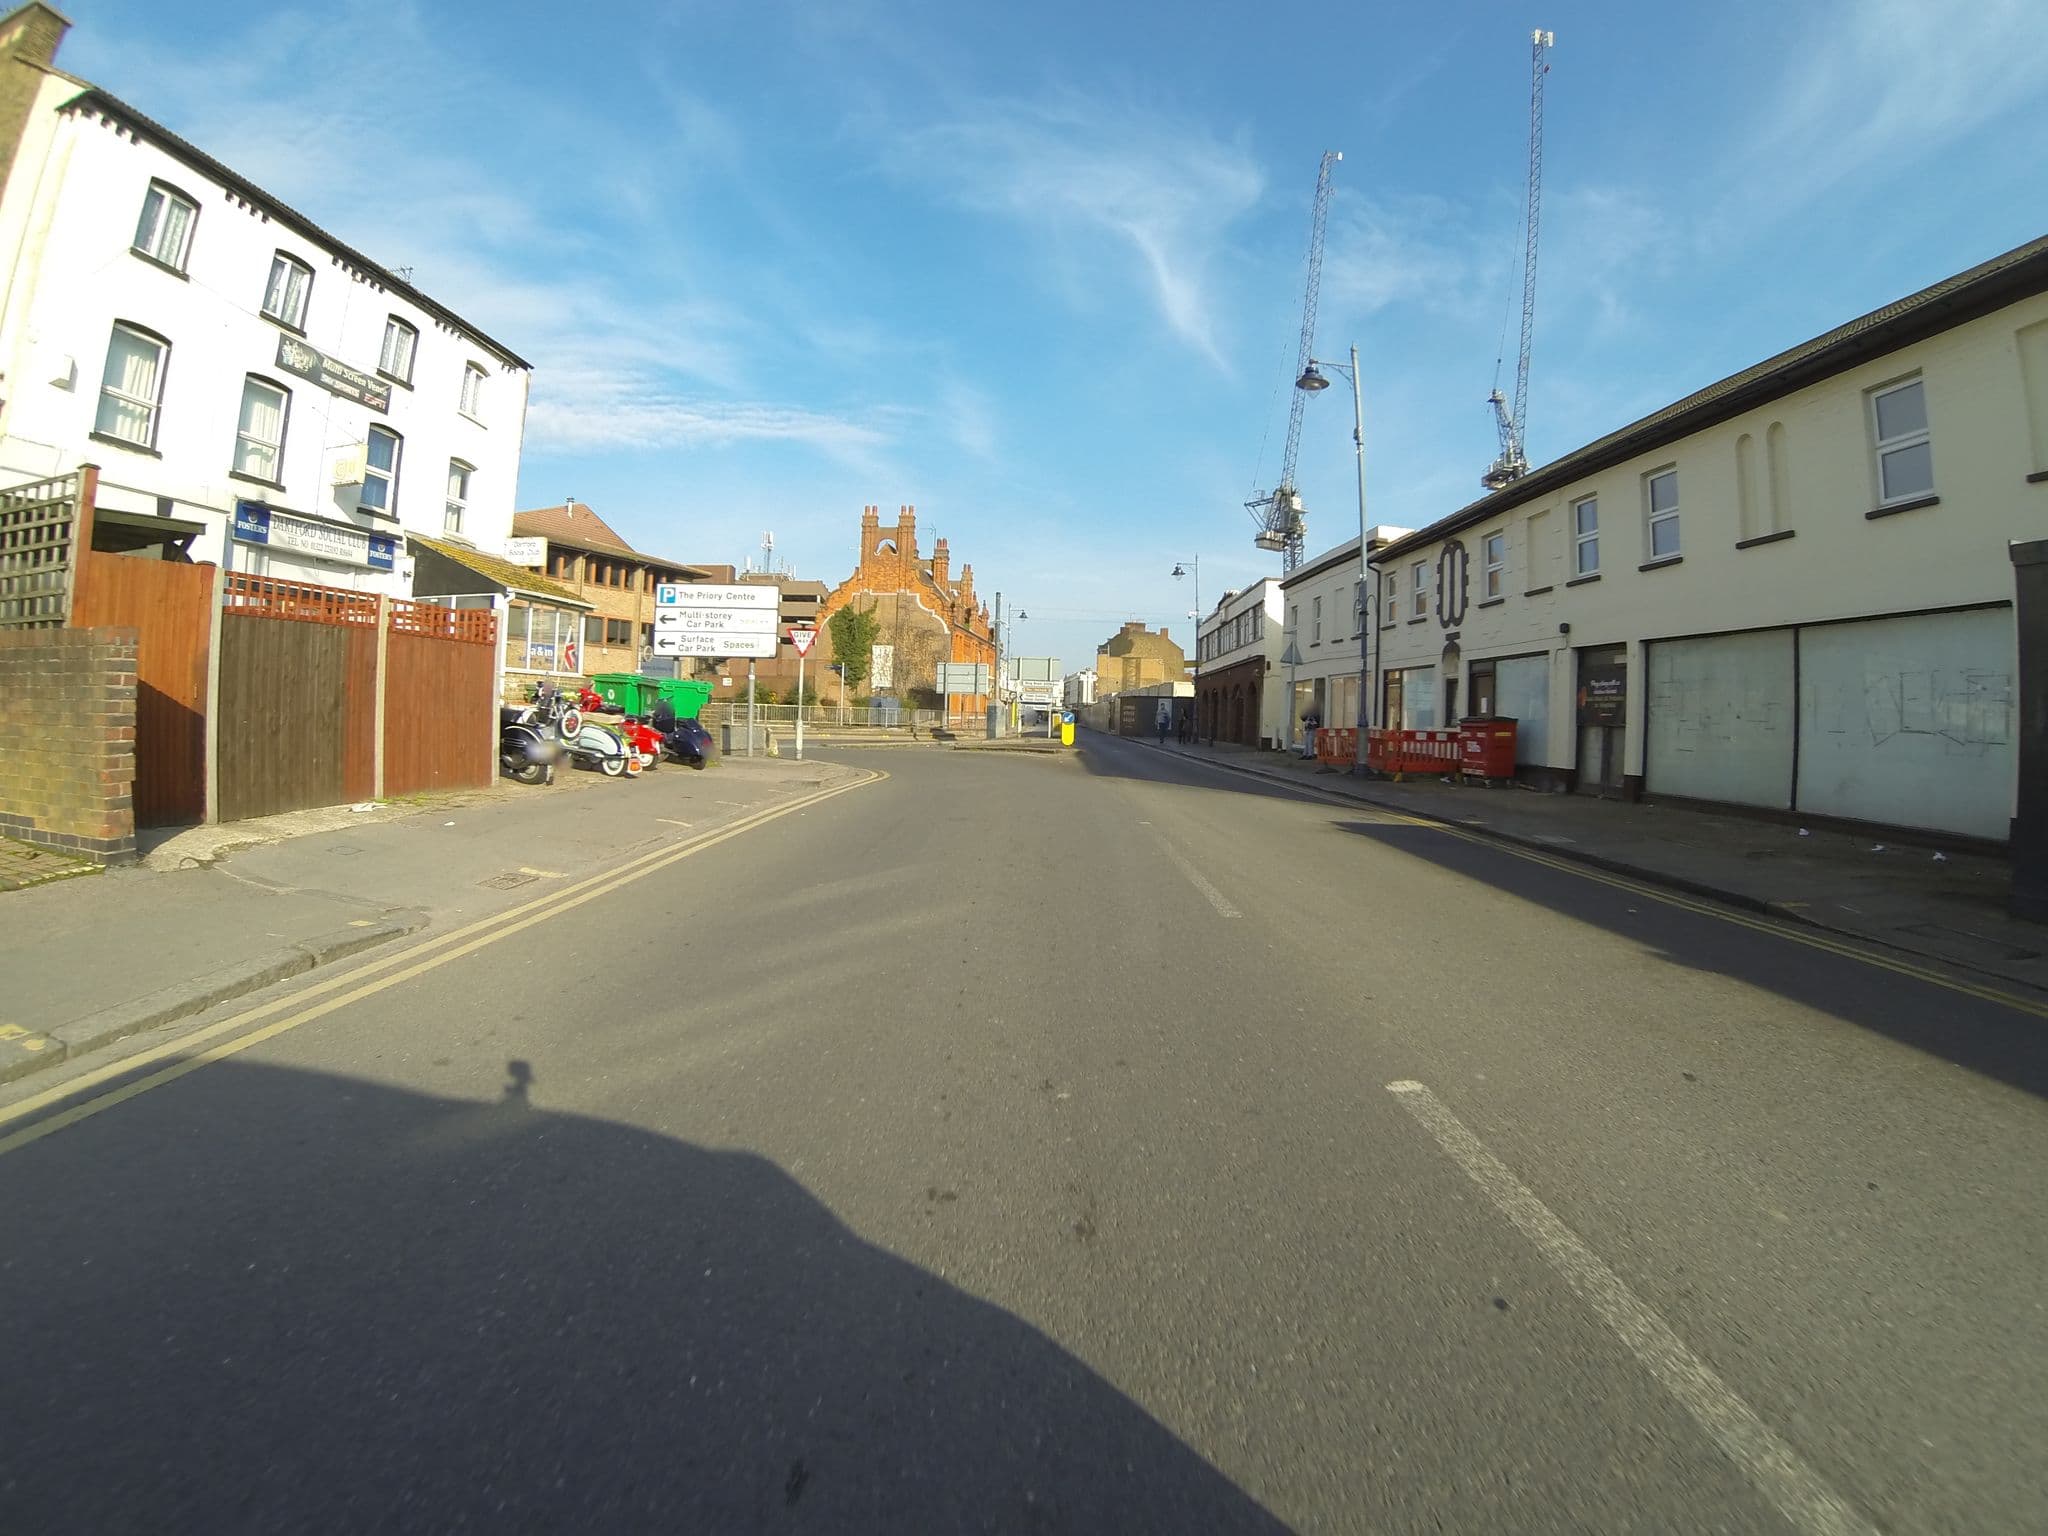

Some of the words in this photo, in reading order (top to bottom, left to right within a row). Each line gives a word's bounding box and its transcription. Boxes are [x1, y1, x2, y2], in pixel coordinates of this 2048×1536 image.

[343, 370, 367, 387] Screen
[272, 513, 317, 539] DARTFORD
[318, 524, 347, 546] SOCIAL
[347, 532, 367, 549] CLUB
[679, 591, 694, 600] The
[697, 591, 723, 603] Priory
[726, 592, 756, 601] Centre
[679, 610, 732, 622] Multi-storey
[686, 621, 702, 629] Car
[704, 621, 725, 629] Park
[680, 634, 715, 643] Surface
[793, 631, 812, 639] GIVE
[723, 640, 755, 650] Spaces
